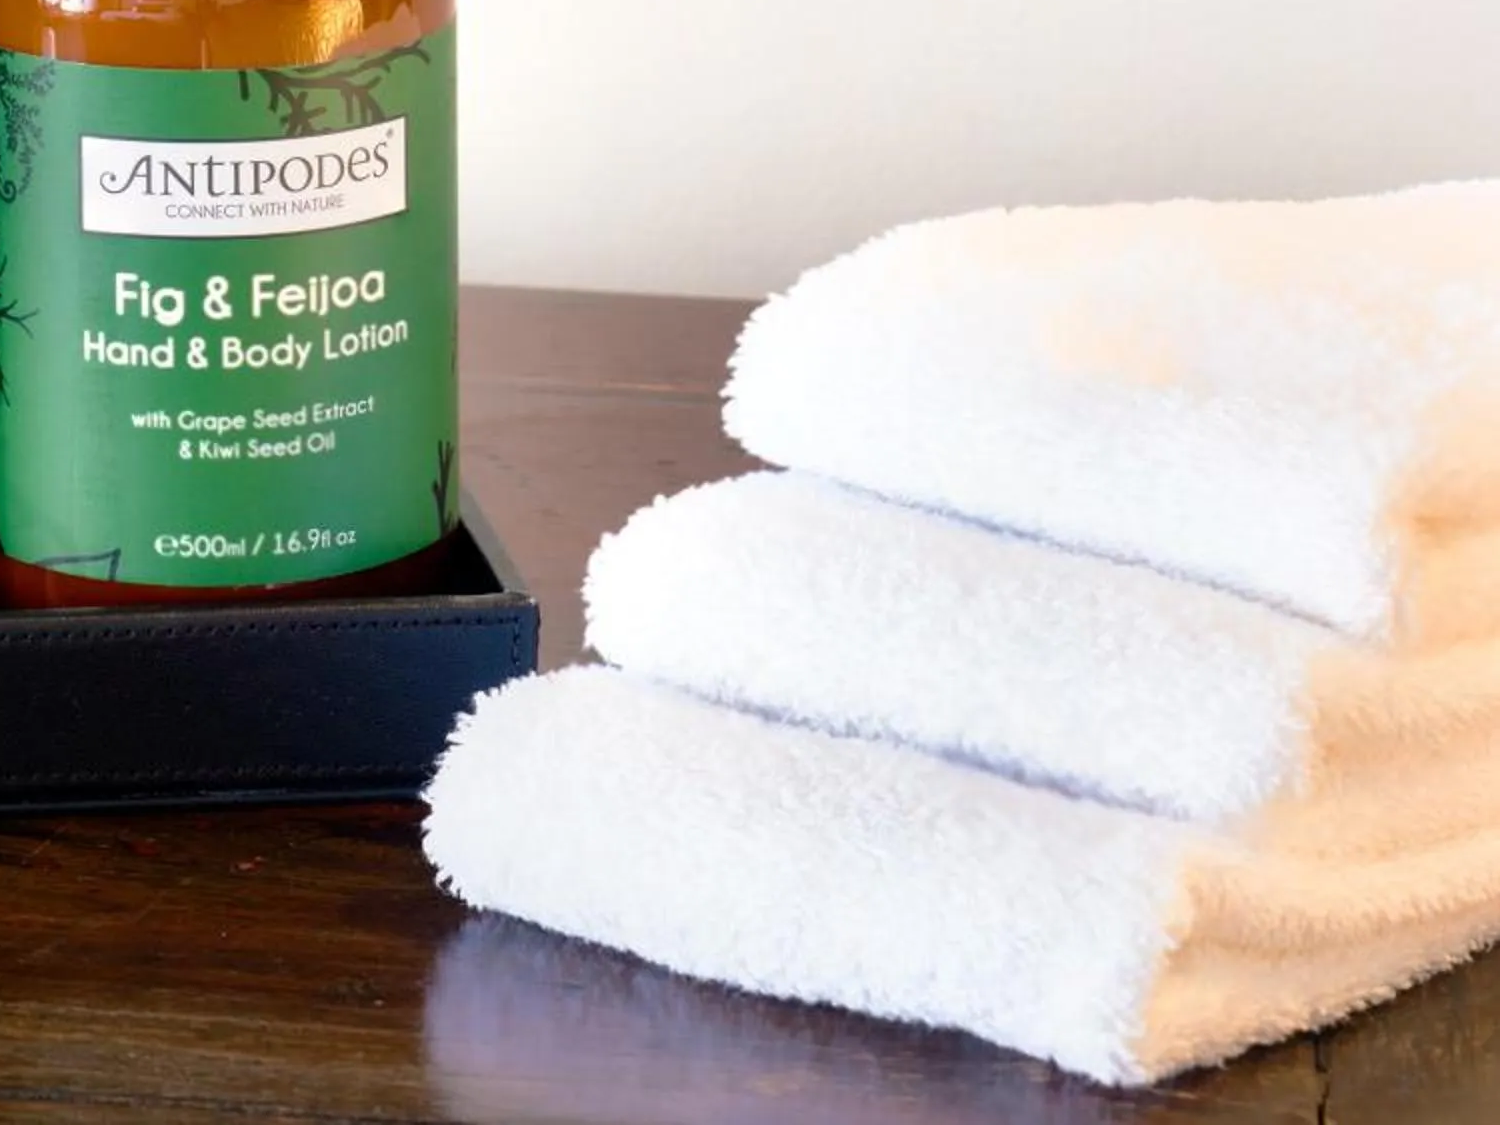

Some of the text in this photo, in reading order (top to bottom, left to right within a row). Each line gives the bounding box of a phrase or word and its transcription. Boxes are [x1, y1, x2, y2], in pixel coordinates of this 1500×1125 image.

[165, 194, 344, 220] CONNECT WITH NATURE
[115, 270, 385, 326] Fig & Feijoa
[83, 319, 408, 371] Hand & Body Lotion
[131, 395, 374, 435] with Grape Seed Extract
[179, 430, 335, 460] & Kiwi Seed Oil
[272, 528, 331, 555] 16.9fl
[335, 529, 356, 546] oz
